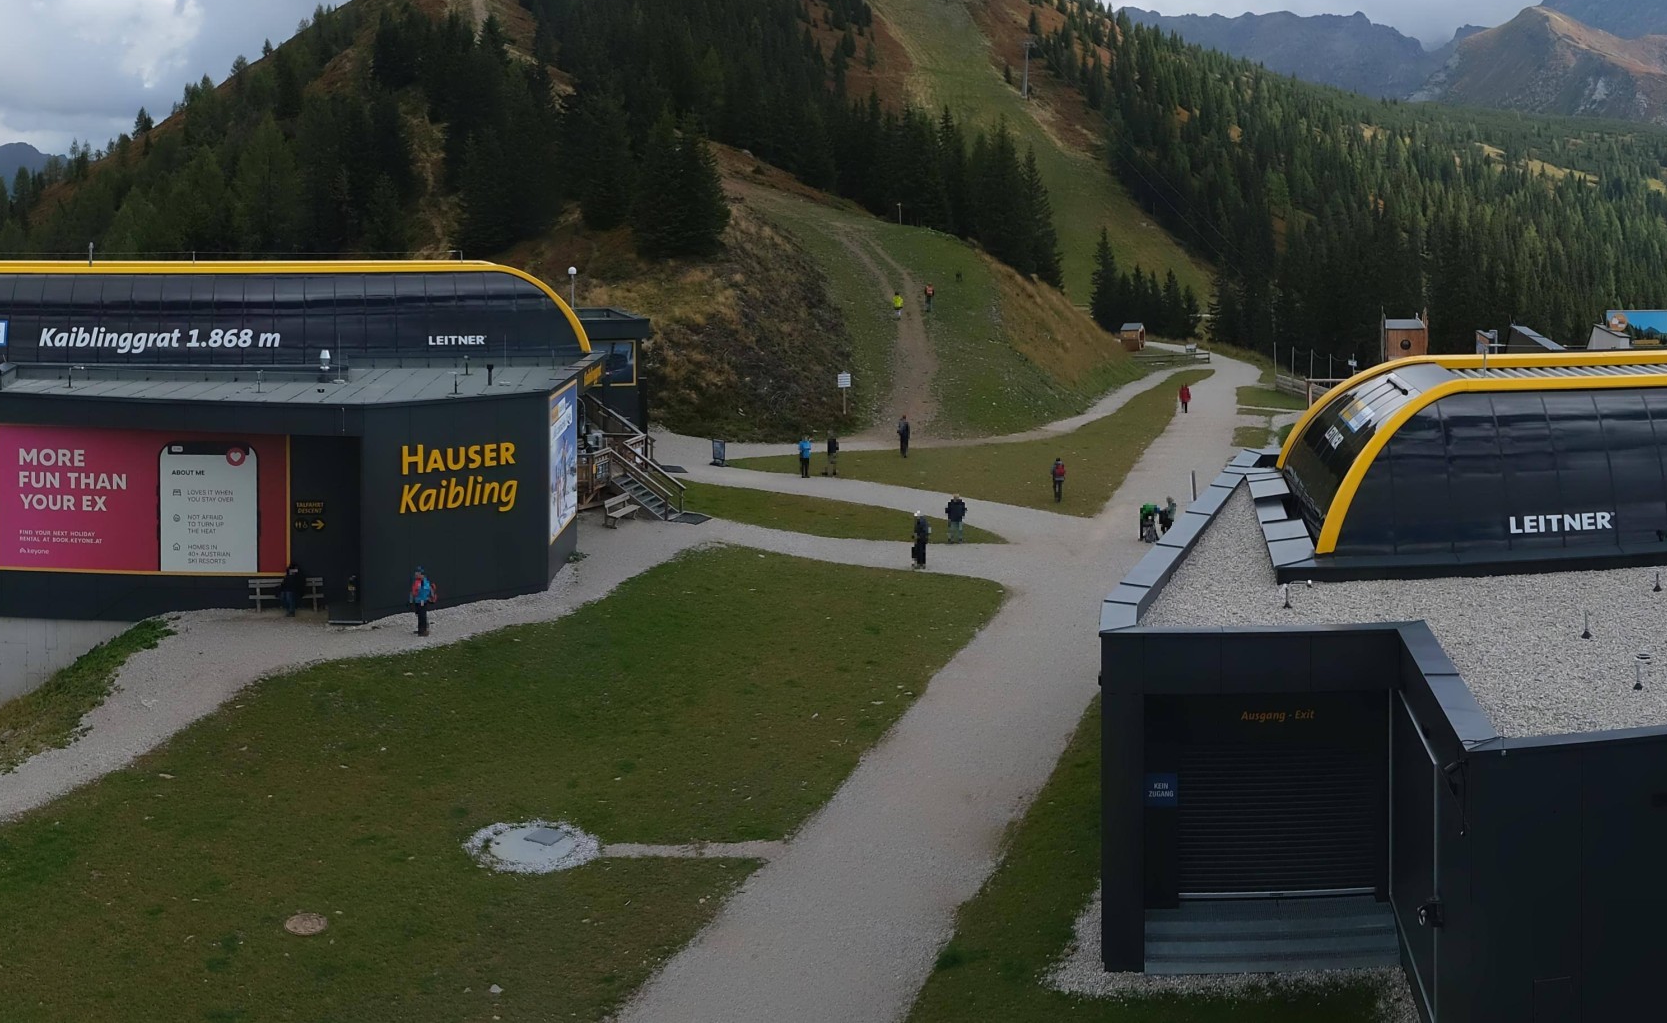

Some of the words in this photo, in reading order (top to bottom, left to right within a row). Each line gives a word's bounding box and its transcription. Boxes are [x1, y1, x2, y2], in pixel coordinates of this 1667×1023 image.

[38, 327, 181, 354] Kaiblinggrat
[186, 328, 253, 348] 1.868
[258, 331, 281, 348] m
[19, 448, 85, 467] MORE
[401, 442, 516, 475] HAUSER
[19, 471, 60, 488] FUN
[67, 472, 127, 490] THAN
[20, 494, 75, 511] YOUR
[82, 495, 107, 511] EX
[399, 475, 518, 514] Kaibling
[1509, 511, 1613, 534] LEITNER
[1240, 710, 1286, 723] Ausgang
[1295, 709, 1316, 719] Exit
[1148, 790, 1174, 798] ZUGANG
[1153, 782, 1169, 790] KEIN
